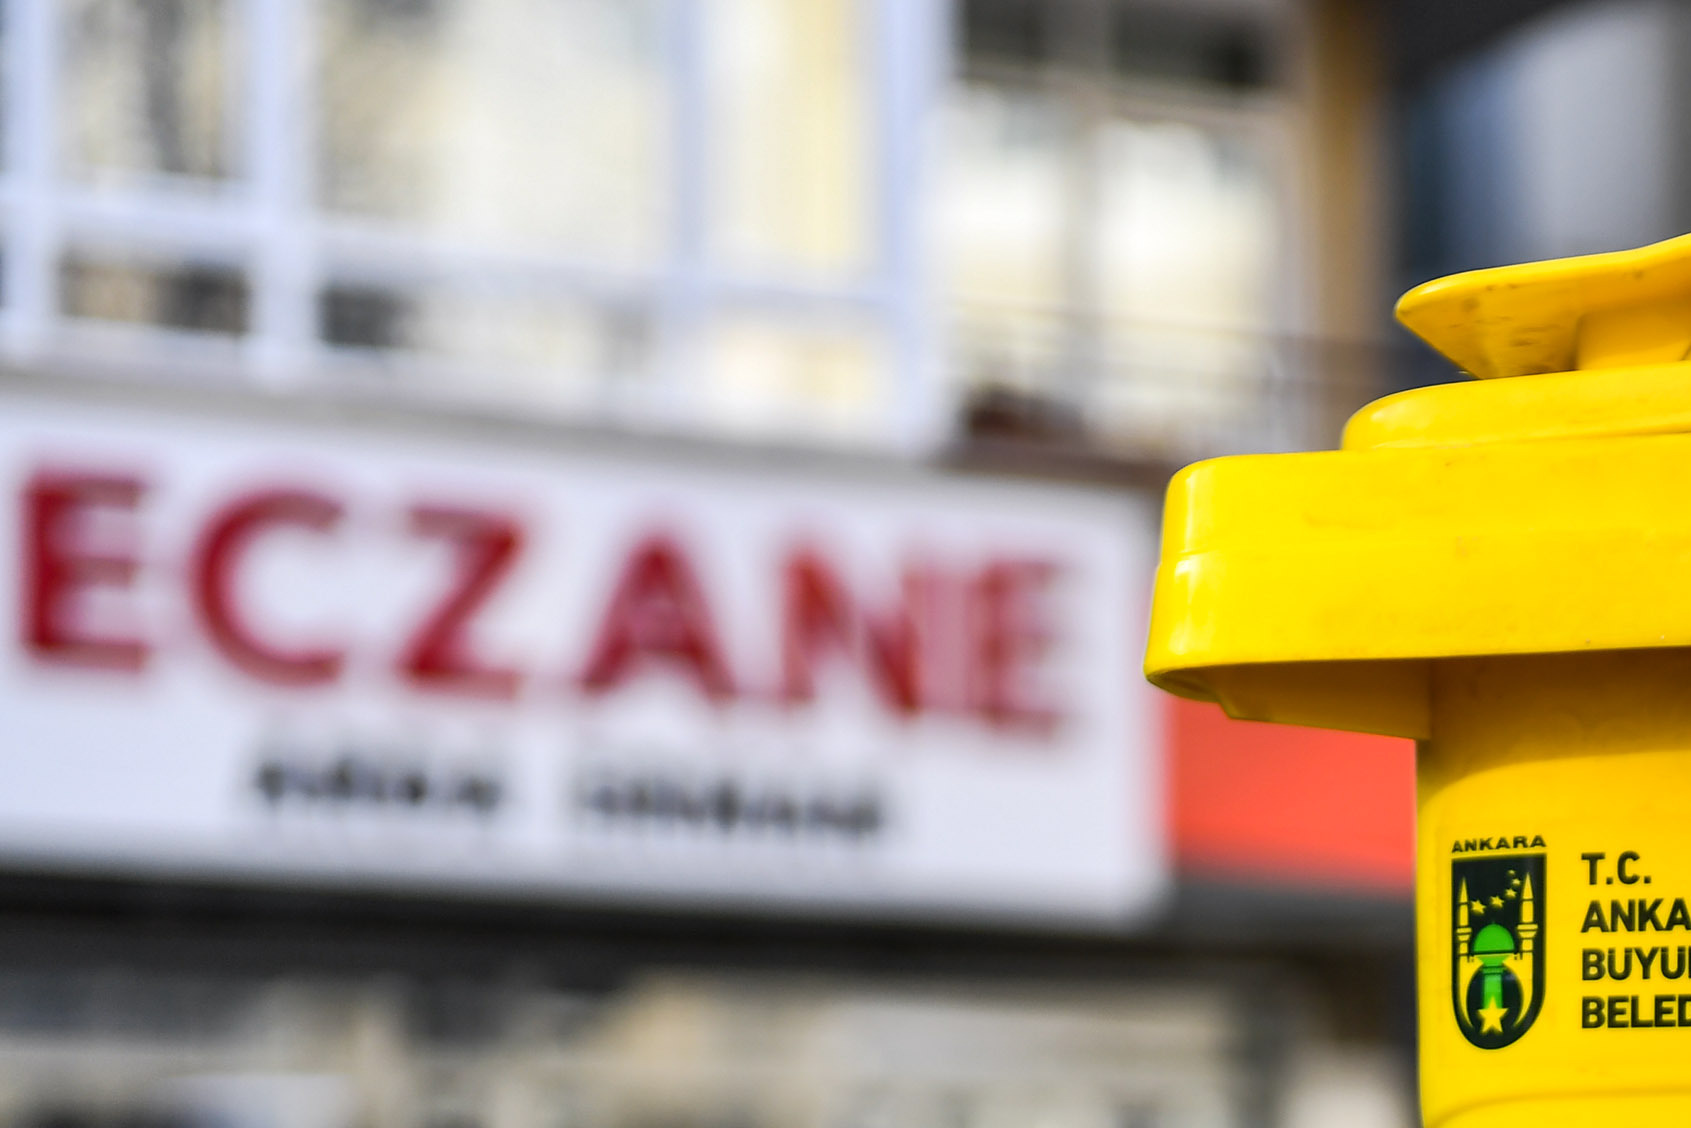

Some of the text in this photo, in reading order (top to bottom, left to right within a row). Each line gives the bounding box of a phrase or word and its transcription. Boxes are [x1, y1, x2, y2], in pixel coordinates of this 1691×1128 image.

[16, 468, 1068, 740] ECZANE
[1451, 834, 1546, 853] ANKARA
[1580, 851, 1652, 886] T.C.
